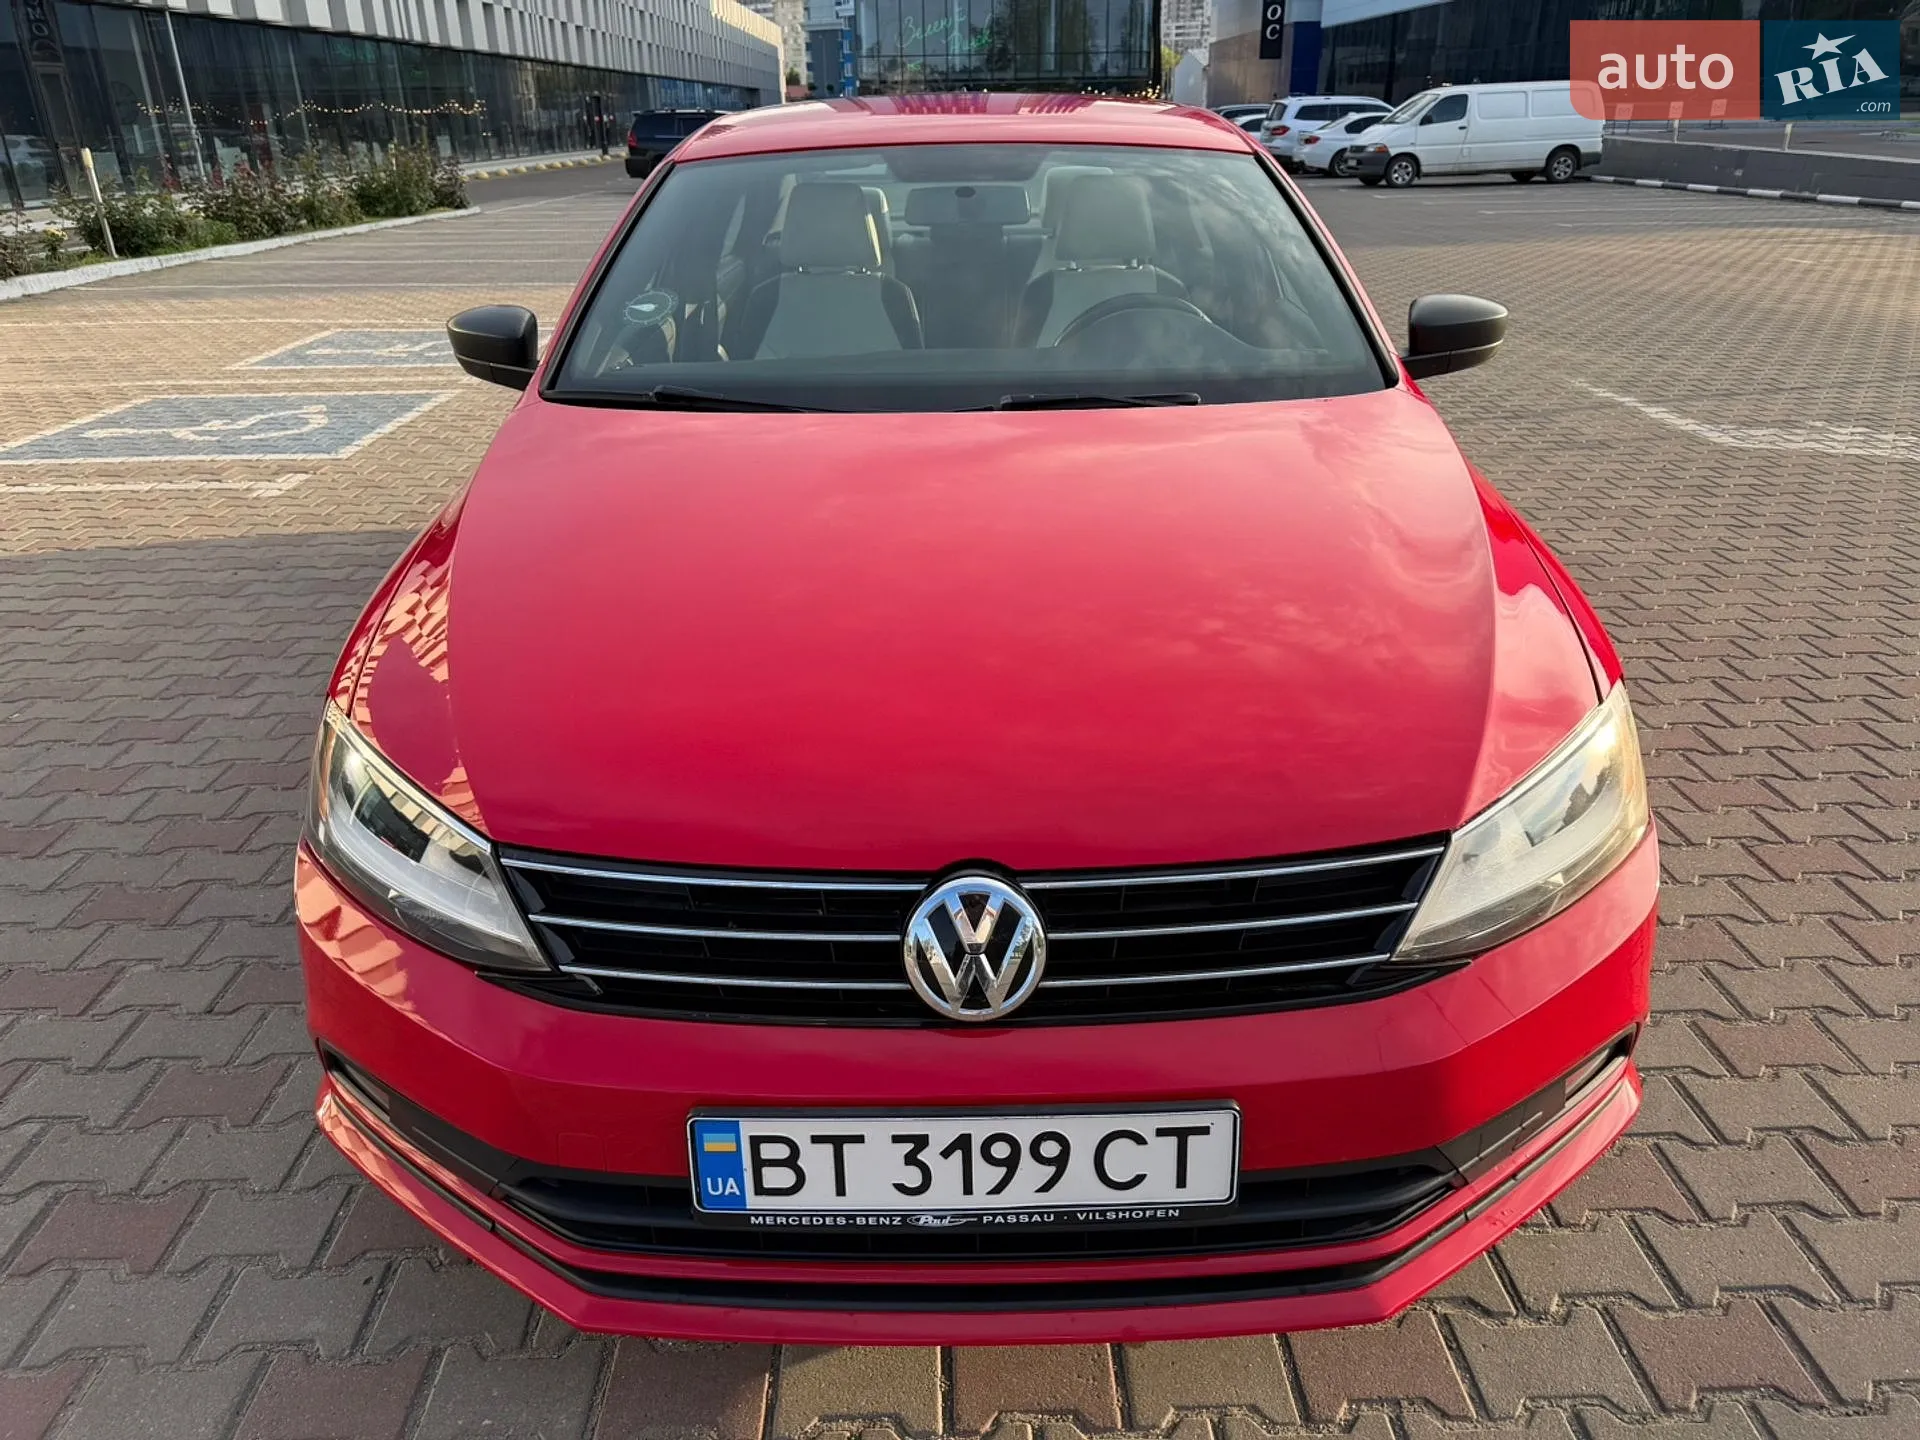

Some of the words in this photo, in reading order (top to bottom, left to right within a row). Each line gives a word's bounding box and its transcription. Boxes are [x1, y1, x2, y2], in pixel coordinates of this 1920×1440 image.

[749, 1134, 865, 1197] BT
[891, 1130, 1071, 1197] 3199
[1093, 1125, 1211, 1191] CT
[706, 1177, 741, 1196] UA
[750, 1215, 903, 1226] MERCEDES-BENZ
[982, 1213, 1055, 1224] PASSAU
[1076, 1209, 1180, 1221] VILSHOFEN
